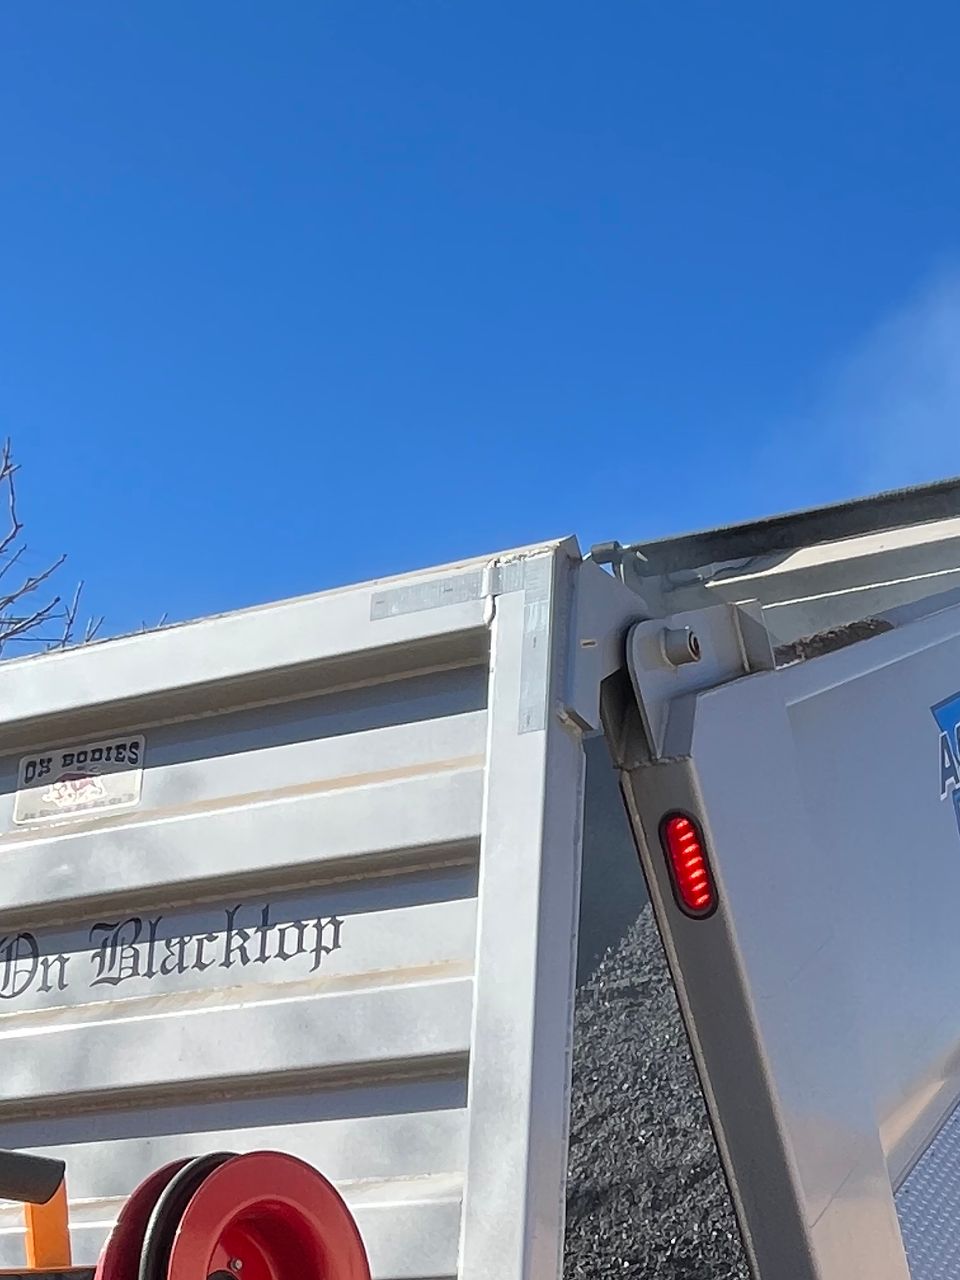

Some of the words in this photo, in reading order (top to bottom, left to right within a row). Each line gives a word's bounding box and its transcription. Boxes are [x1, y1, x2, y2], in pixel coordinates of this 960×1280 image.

[24, 757, 53, 784] OX
[61, 741, 140, 768] BODIES
[0, 931, 71, 999] On
[89, 904, 345, 988] Blacktop
